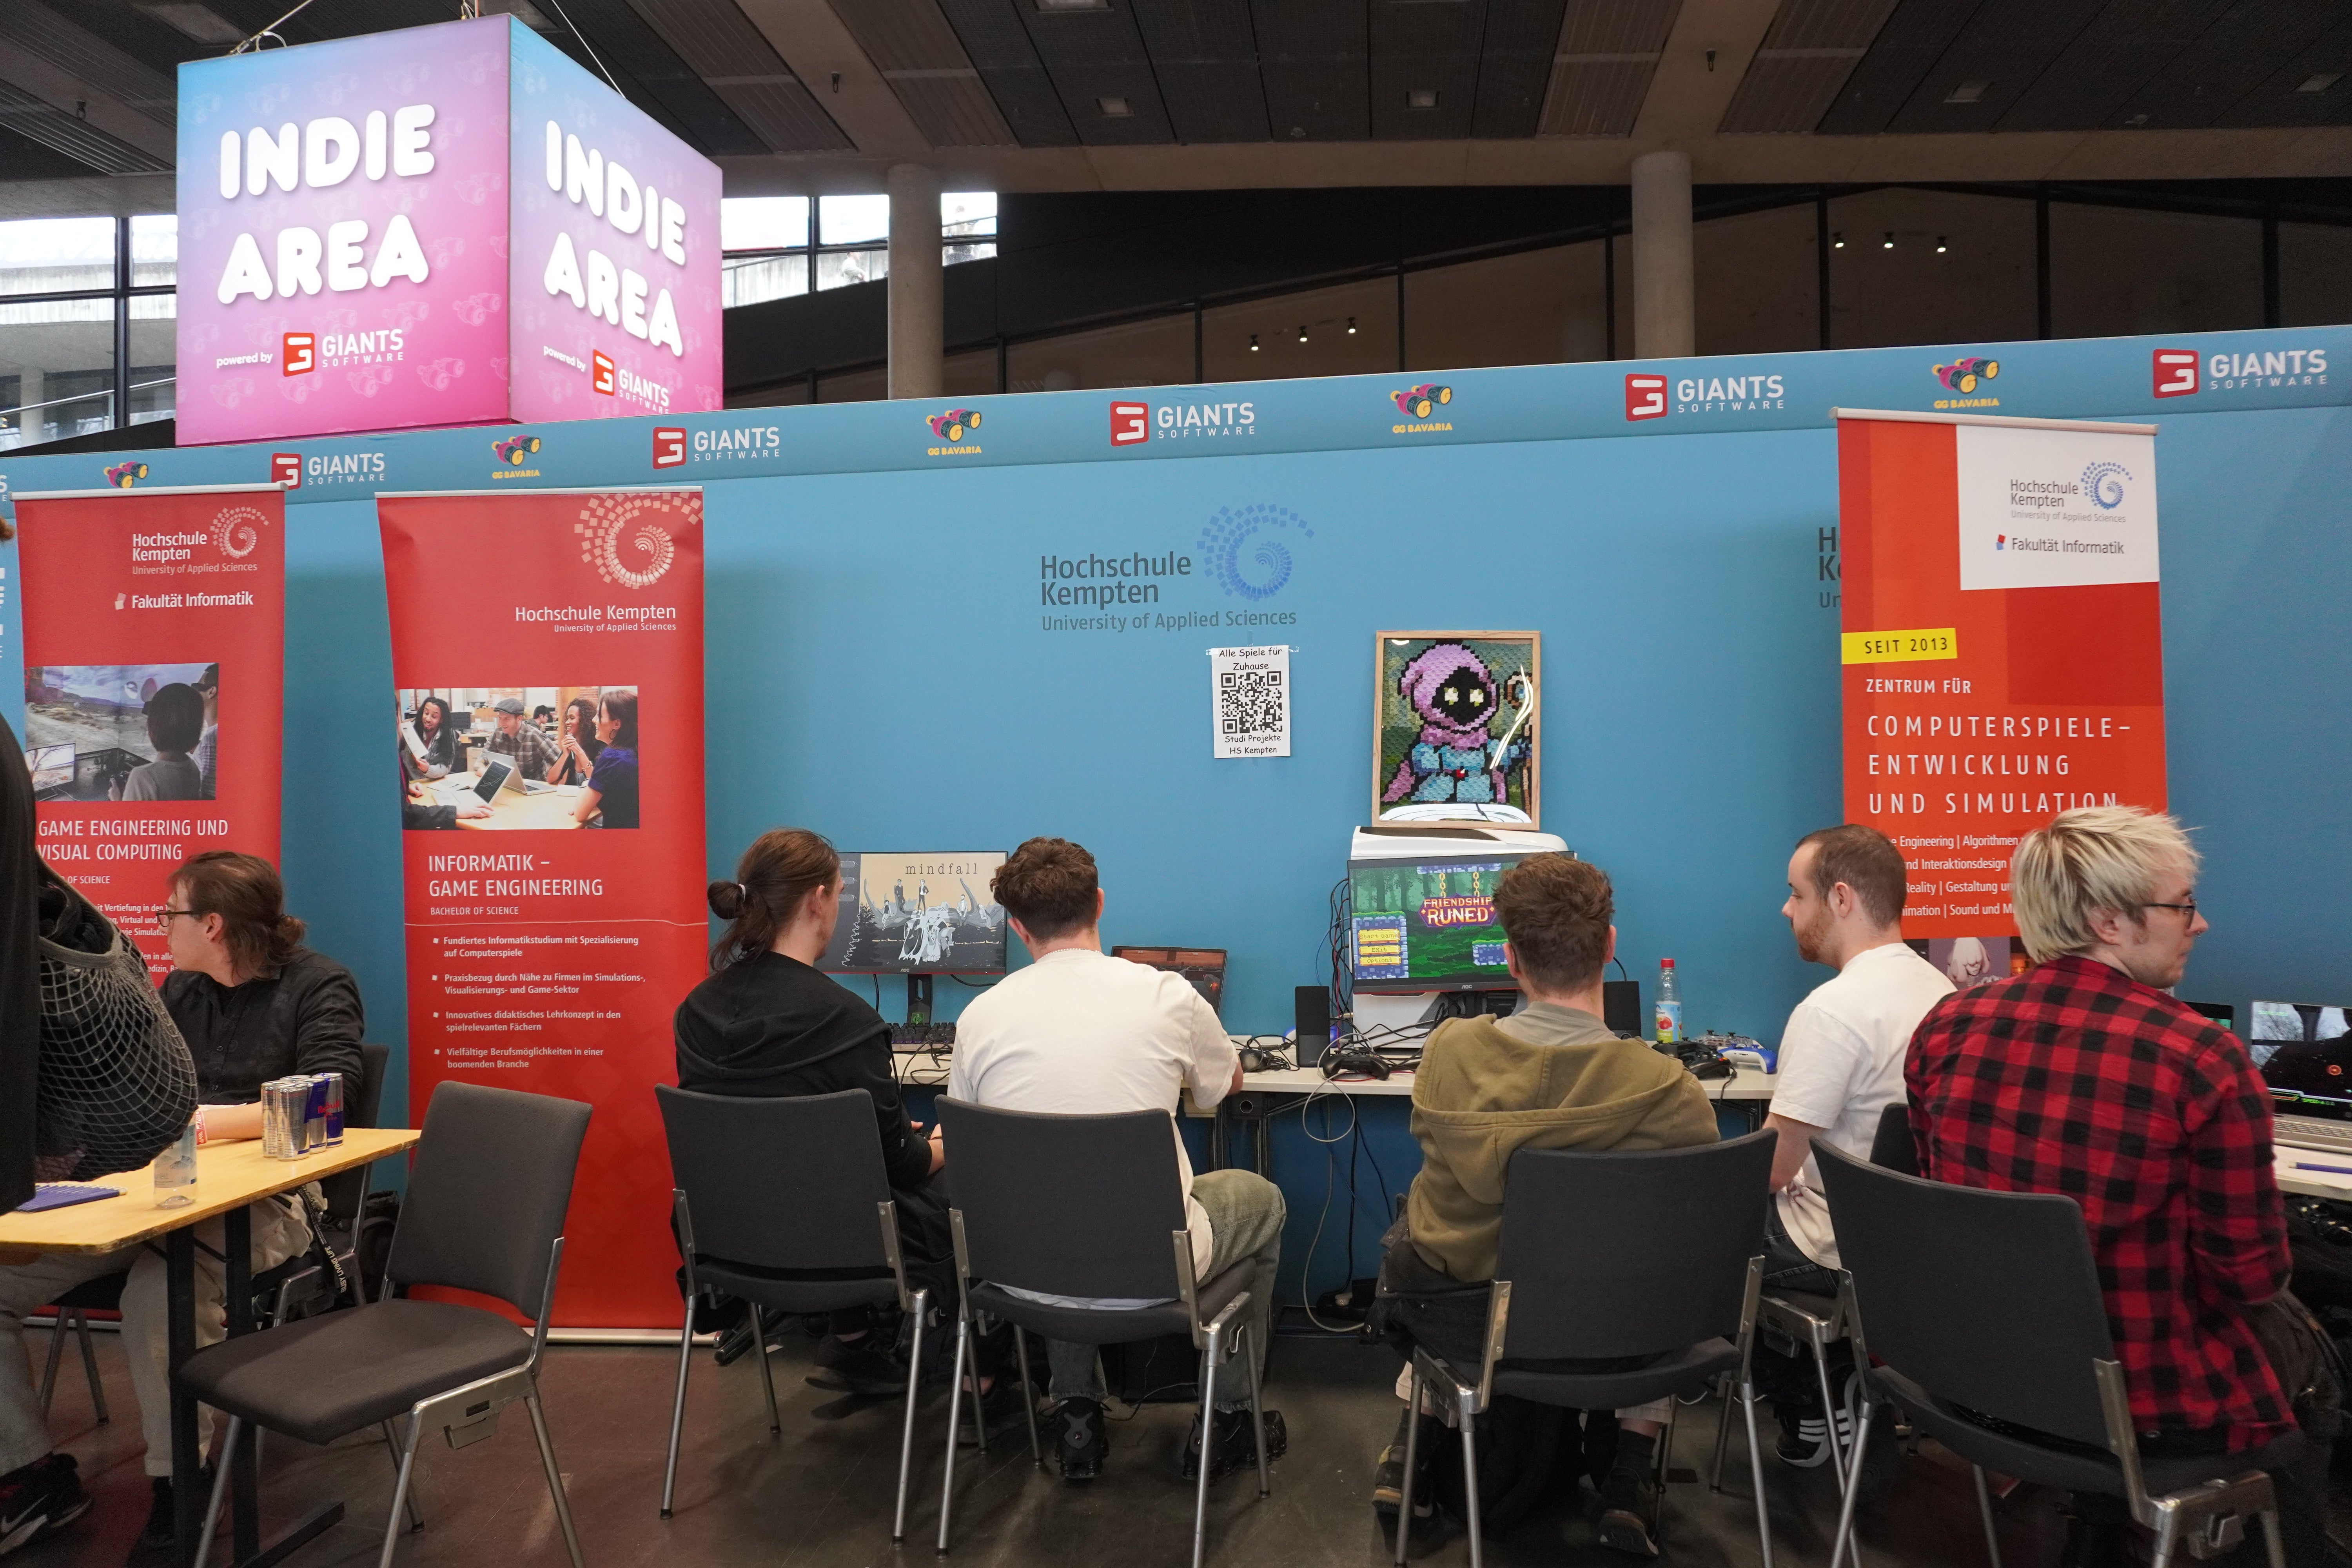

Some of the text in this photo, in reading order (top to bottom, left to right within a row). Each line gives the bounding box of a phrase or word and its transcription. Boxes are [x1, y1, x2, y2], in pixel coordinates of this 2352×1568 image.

[220, 104, 435, 199] INDIE
[546, 120, 686, 266] INDIE
[217, 214, 429, 304] AREA
[544, 232, 683, 356] AREA
[322, 329, 403, 357] GIANTS
[216, 352, 272, 368] powered by
[322, 352, 403, 368] SOFTWARE
[544, 345, 586, 372] powered by
[2210, 350, 2327, 377] GIANTS
[619, 370, 669, 407] GIANTS
[1677, 375, 1784, 401] GIANTS
[2210, 376, 2327, 390] SOFTWARE
[619, 390, 669, 414] SOFTWARE
[1678, 400, 1784, 413] SOFTWARE
[1934, 397, 1999, 408] GG BAVARIA
[1158, 403, 1255, 428] GIANTS
[1158, 426, 1255, 439] SOFTWARE
[1392, 423, 1452, 433] GG BAVARIA
[694, 427, 779, 452] GIANTS
[694, 449, 780, 461] SOFTWARE
[942, 446, 982, 455] BAVARIA
[309, 453, 385, 476] GIANTS
[309, 474, 385, 485] SOFTWARE
[504, 470, 540, 479] BAVARIA
[2011, 479, 2078, 494] Hochschule
[2011, 493, 2064, 508] Kempten
[2011, 510, 2126, 523] University of Applied Sciences
[132, 532, 207, 547] Hochschule
[2012, 537, 2124, 554] Fakultät Informatik
[132, 547, 191, 564] Kempten
[132, 562, 257, 575] University of Applied Sciences
[1041, 551, 1191, 579] Hochschule
[132, 591, 253, 608] Fakultät Informatik
[1042, 581, 1159, 610] Kempten
[515, 605, 676, 623] Hochschule Kempten
[1042, 610, 1296, 633] University of Applied Sciences
[554, 622, 676, 633] University of Applied Sciences
[1239, 648, 1265, 658] Spiele
[1269, 647, 1282, 655] für
[1865, 637, 1948, 653] SEIT 2013
[1866, 678, 1971, 693] ZENTRUM FÜR
[1249, 734, 1281, 743] Projekte
[1245, 747, 1277, 755] Kempten
[1869, 755, 2069, 775] ENTWICKLUNG
[1869, 793, 2116, 814] UND SIMULATION
[39, 820, 229, 836] GAME ENGINEERING UND
[1900, 836, 1954, 849] Engineering
[1963, 835, 2018, 849] Algorithmen
[37, 844, 182, 860] VISUAL COMPUTING
[428, 855, 534, 872] INFORMATIK
[905, 863, 977, 875] mindfall
[1922, 858, 2007, 871] Interaktionsdesign
[429, 878, 603, 897] GAME ENGINEERING
[1946, 880, 1998, 894] Gestaltung
[2001, 882, 2014, 891] un
[105, 904, 141, 913] Vertiefung
[430, 906, 519, 915] BACHELOR OF SCIENCE
[1424, 897, 1493, 909] FRIENDSHIP
[1902, 905, 1940, 916] nimation
[1950, 904, 1979, 915] Sound
[1982, 903, 2000, 914] und
[1427, 907, 1489, 926] RUNED
[443, 935, 638, 946] Fundiertes Informatikstudium mit Spezialisierung
[444, 949, 522, 959] auf Computerspiele
[445, 973, 492, 984] Praxisbezug
[494, 972, 517, 982] durch
[519, 972, 540, 982] Nähe
[554, 972, 580, 982] Firmen
[583, 972, 592, 981] im
[595, 972, 646, 983] Simulations-,
[445, 984, 579, 996] Visualisierungs- und Game-Sektor
[446, 1009, 621, 1021] Innovatives didaktisches Lehrkonzept in den
[446, 1022, 541, 1033] spielrelevanten Fächern
[447, 1047, 603, 1058] Vielfältige Berufsmöglichkeiten in einer
[447, 1059, 529, 1069] boomenden Branche
[325, 1246, 335, 1258] LIFE
[331, 1258, 344, 1278] LIVING
